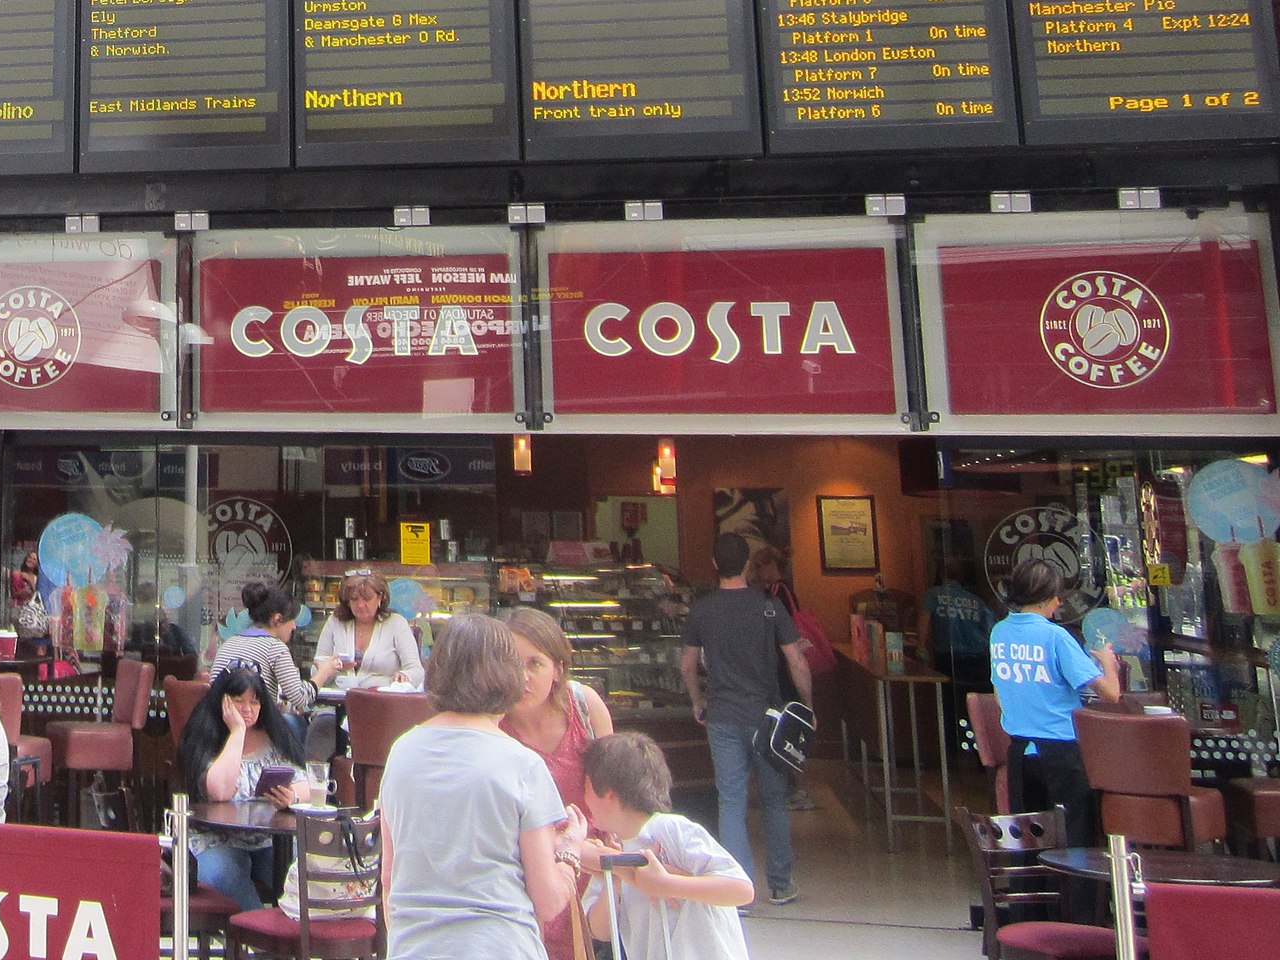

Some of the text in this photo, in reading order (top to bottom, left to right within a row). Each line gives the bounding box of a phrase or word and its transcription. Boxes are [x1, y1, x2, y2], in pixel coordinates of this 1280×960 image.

[778, 9, 908, 26] 13:46 Stalybridge
[305, 88, 403, 109] Northern
[533, 81, 636, 100] Northern
[90, 96, 256, 113] East Midlands Trains
[1109, 91, 1260, 112] Page 1 of 2
[534, 103, 682, 120] Front train only
[1056, 276, 1143, 309] COSTA
[583, 300, 856, 365] COSTA
[1046, 320, 1067, 329] SINCE
[1143, 319, 1160, 328] 1971
[230, 305, 480, 365] COSTA
[1055, 342, 1160, 383] COFFEE
[1010, 645, 1044, 661] COLD
